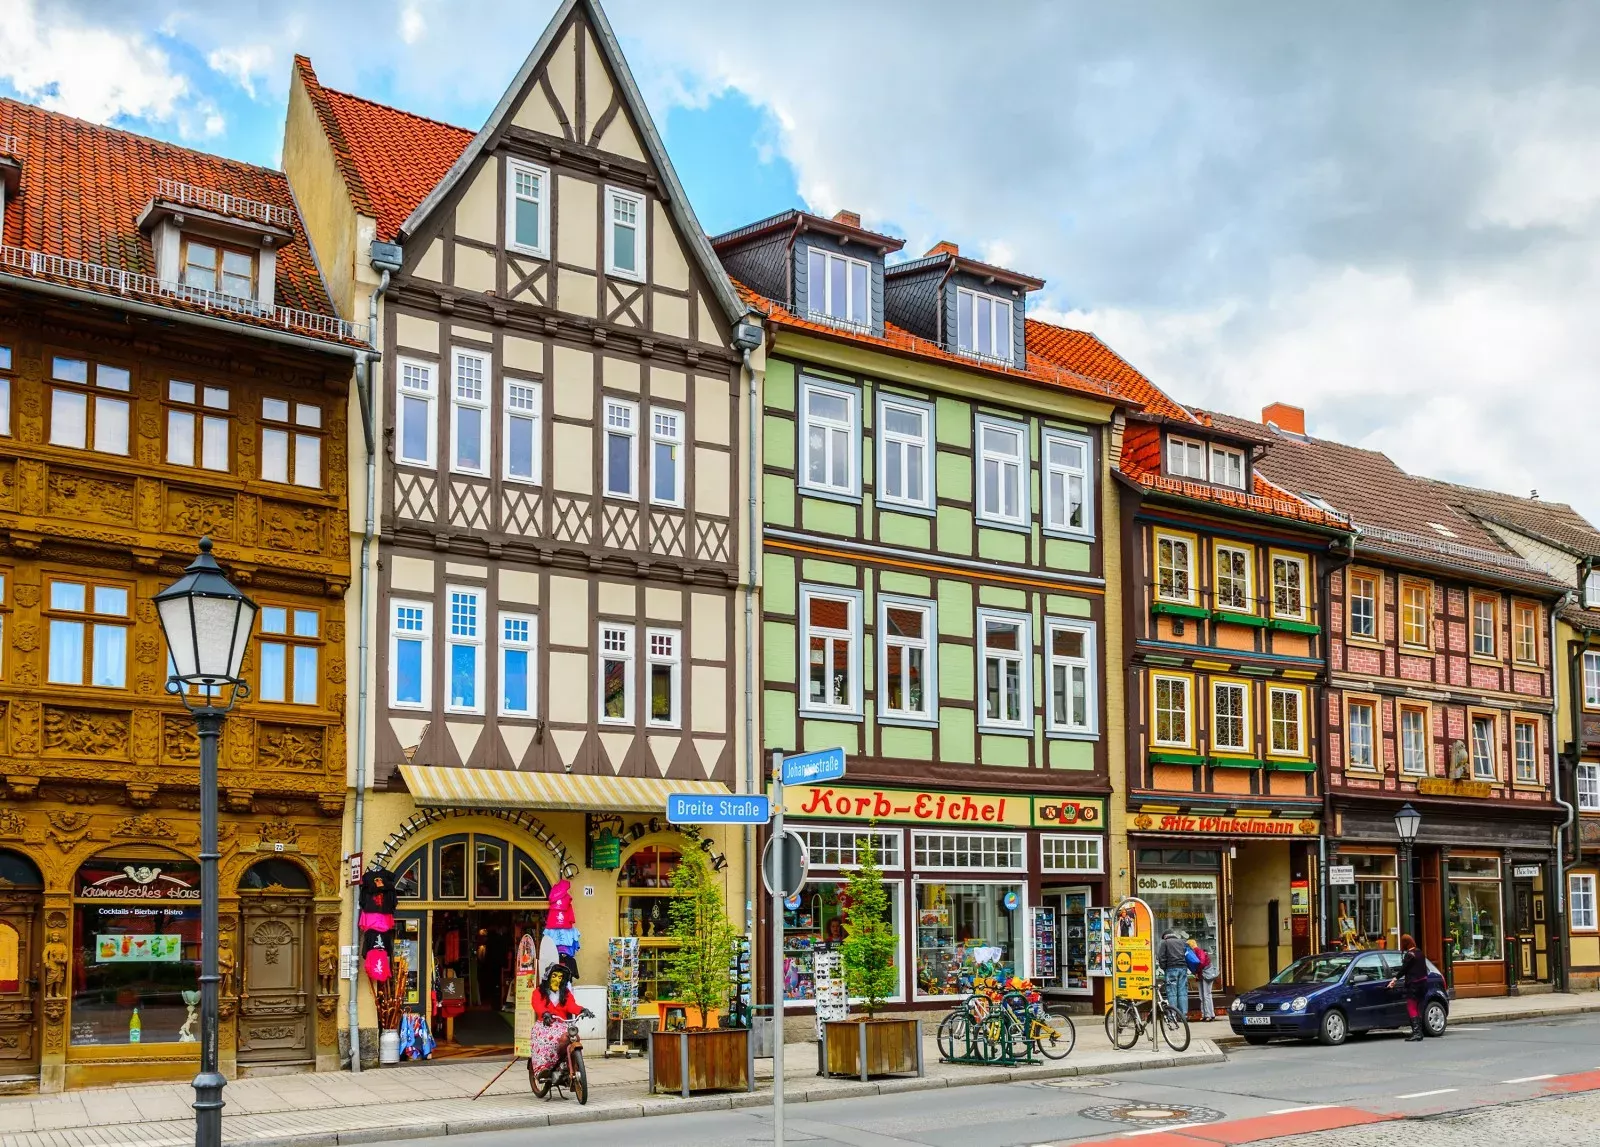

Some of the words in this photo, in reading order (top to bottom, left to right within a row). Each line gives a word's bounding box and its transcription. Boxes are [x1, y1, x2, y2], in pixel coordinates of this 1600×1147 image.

[677, 799, 713, 816] Breite
[720, 800, 760, 817] Straße
[801, 788, 1006, 822] Korb-Eichel
[1158, 815, 1196, 832] Fritz
[1199, 816, 1294, 834] Winkelmann
[167, 887, 200, 899] Haus
[584, 887, 593, 895] 70
